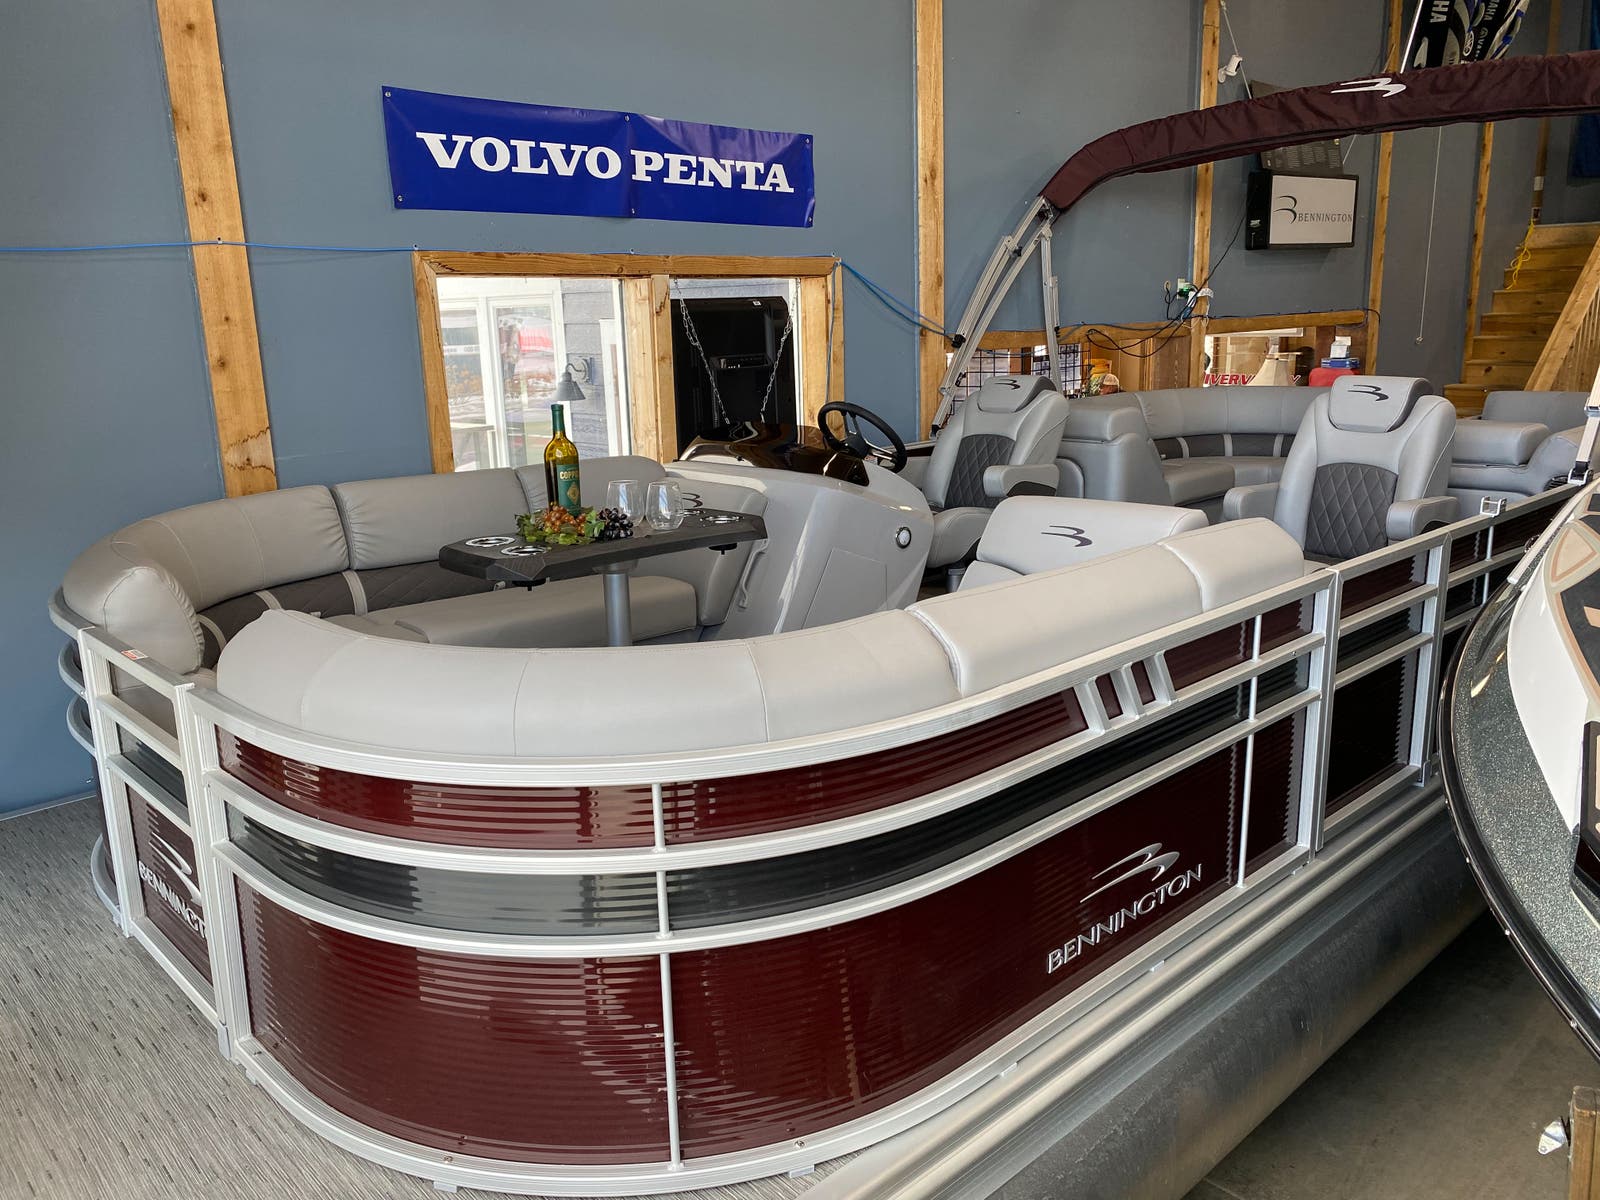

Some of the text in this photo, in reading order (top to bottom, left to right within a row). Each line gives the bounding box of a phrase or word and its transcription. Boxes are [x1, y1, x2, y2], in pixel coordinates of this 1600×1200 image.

[416, 131, 795, 194] VOLVO PENTA
[1298, 212, 1353, 224] BENNINGTON
[1046, 863, 1202, 975] BENNINGTON
